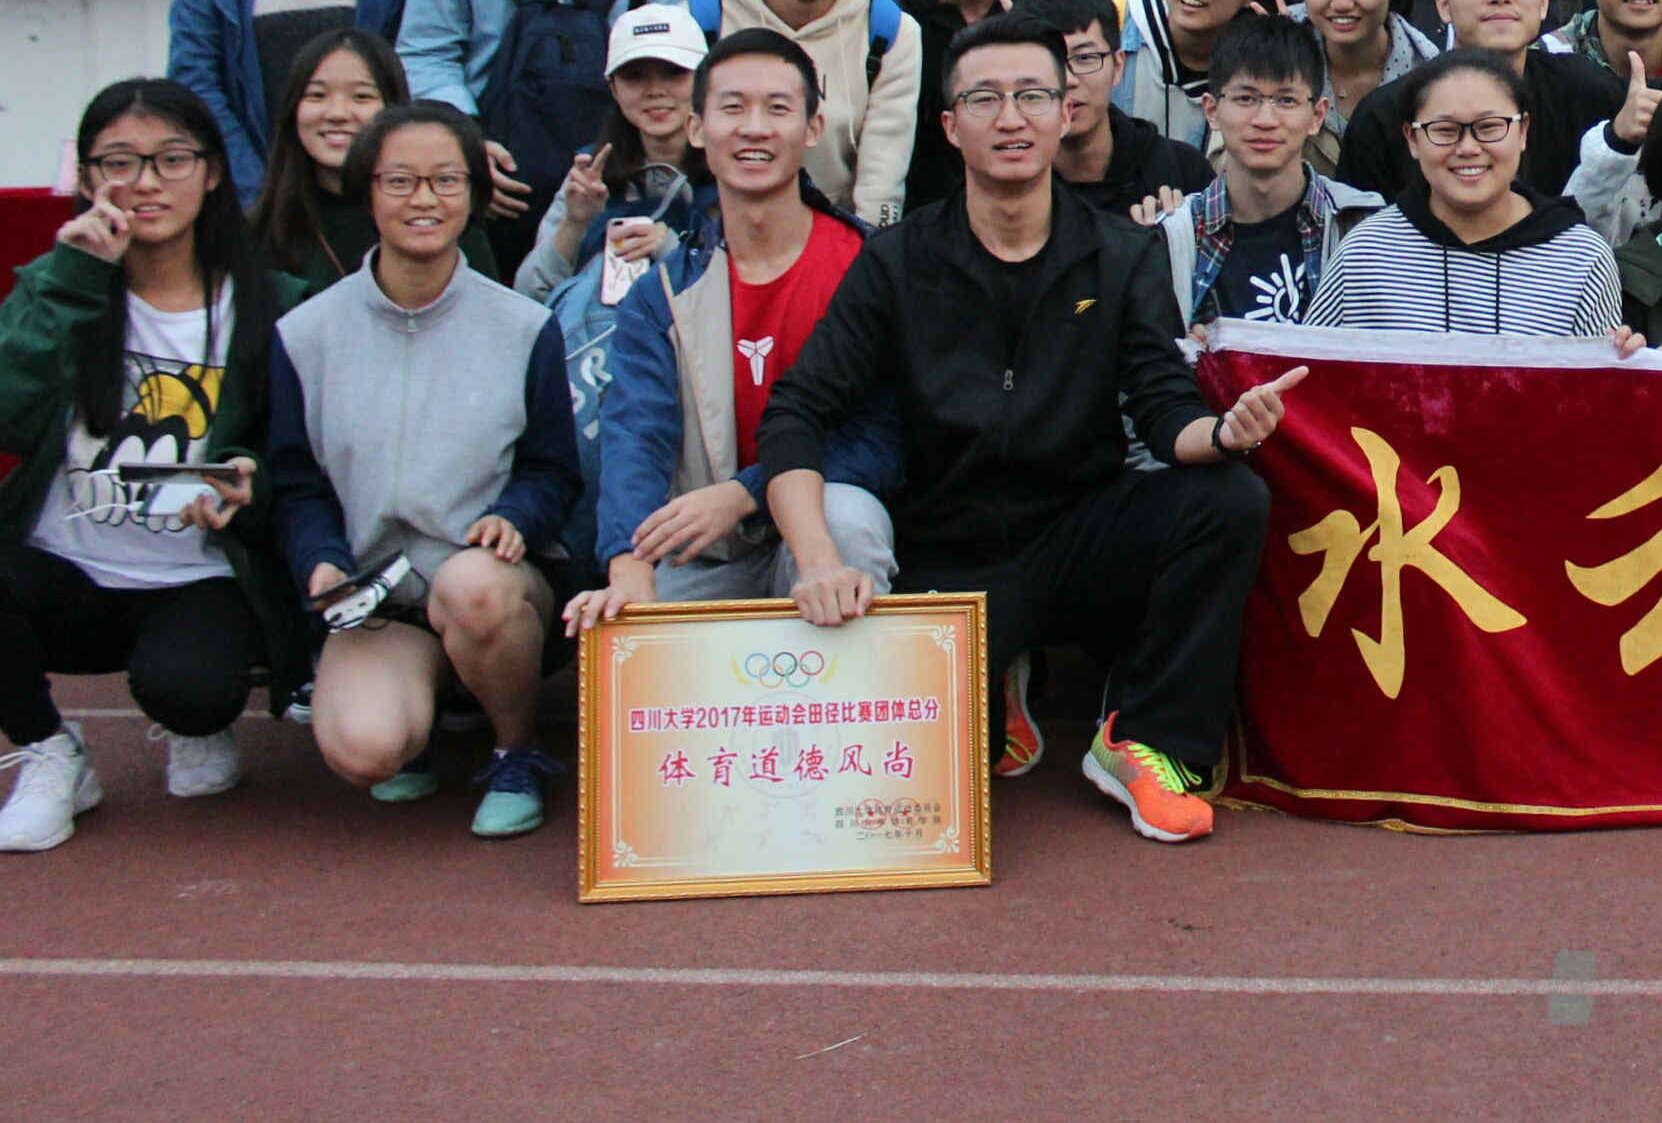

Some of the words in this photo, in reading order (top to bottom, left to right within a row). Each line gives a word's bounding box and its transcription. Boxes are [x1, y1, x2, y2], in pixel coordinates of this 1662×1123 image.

[629, 698, 940, 731] 四川大学2017年运动会田径比赛团体总分
[657, 740, 915, 788] 体育道德风尚
